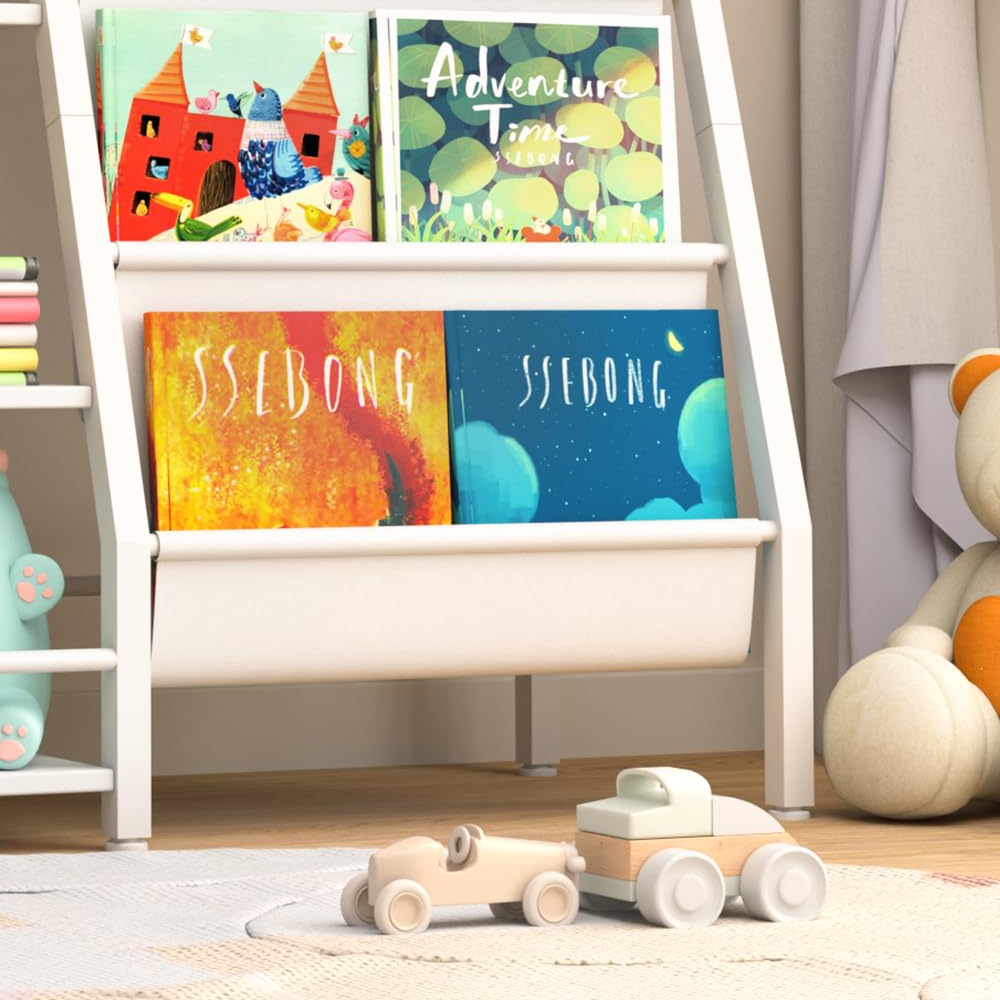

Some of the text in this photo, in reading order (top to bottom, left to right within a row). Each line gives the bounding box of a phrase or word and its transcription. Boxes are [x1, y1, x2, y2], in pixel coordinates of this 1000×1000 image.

[421, 41, 640, 99] Adventure
[472, 103, 591, 145] Time
[495, 151, 575, 166] SSEBONG
[189, 344, 415, 421] SSEBONG
[518, 354, 666, 410] SSEBONG
